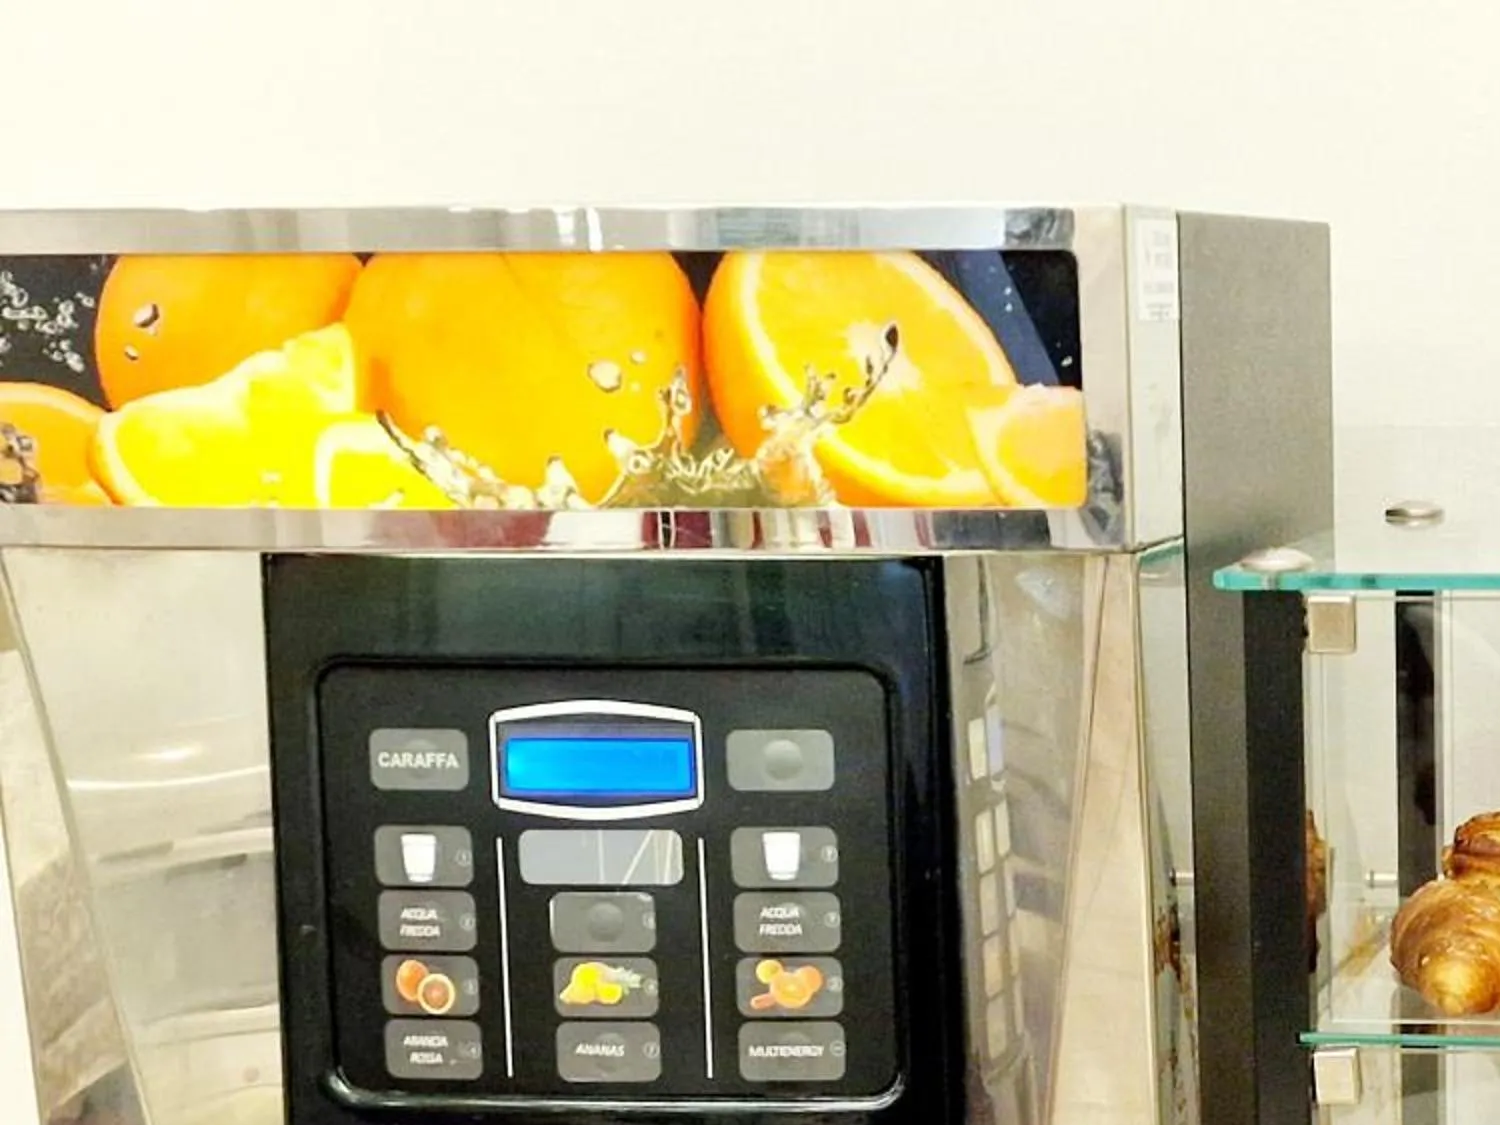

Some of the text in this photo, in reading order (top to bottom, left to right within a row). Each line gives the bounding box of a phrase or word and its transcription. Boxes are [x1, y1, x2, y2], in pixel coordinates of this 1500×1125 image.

[377, 751, 460, 769] CARAFFA
[760, 906, 800, 919] ACQUA
[759, 923, 803, 936] FREDDA
[575, 1042, 625, 1057] ANANAS
